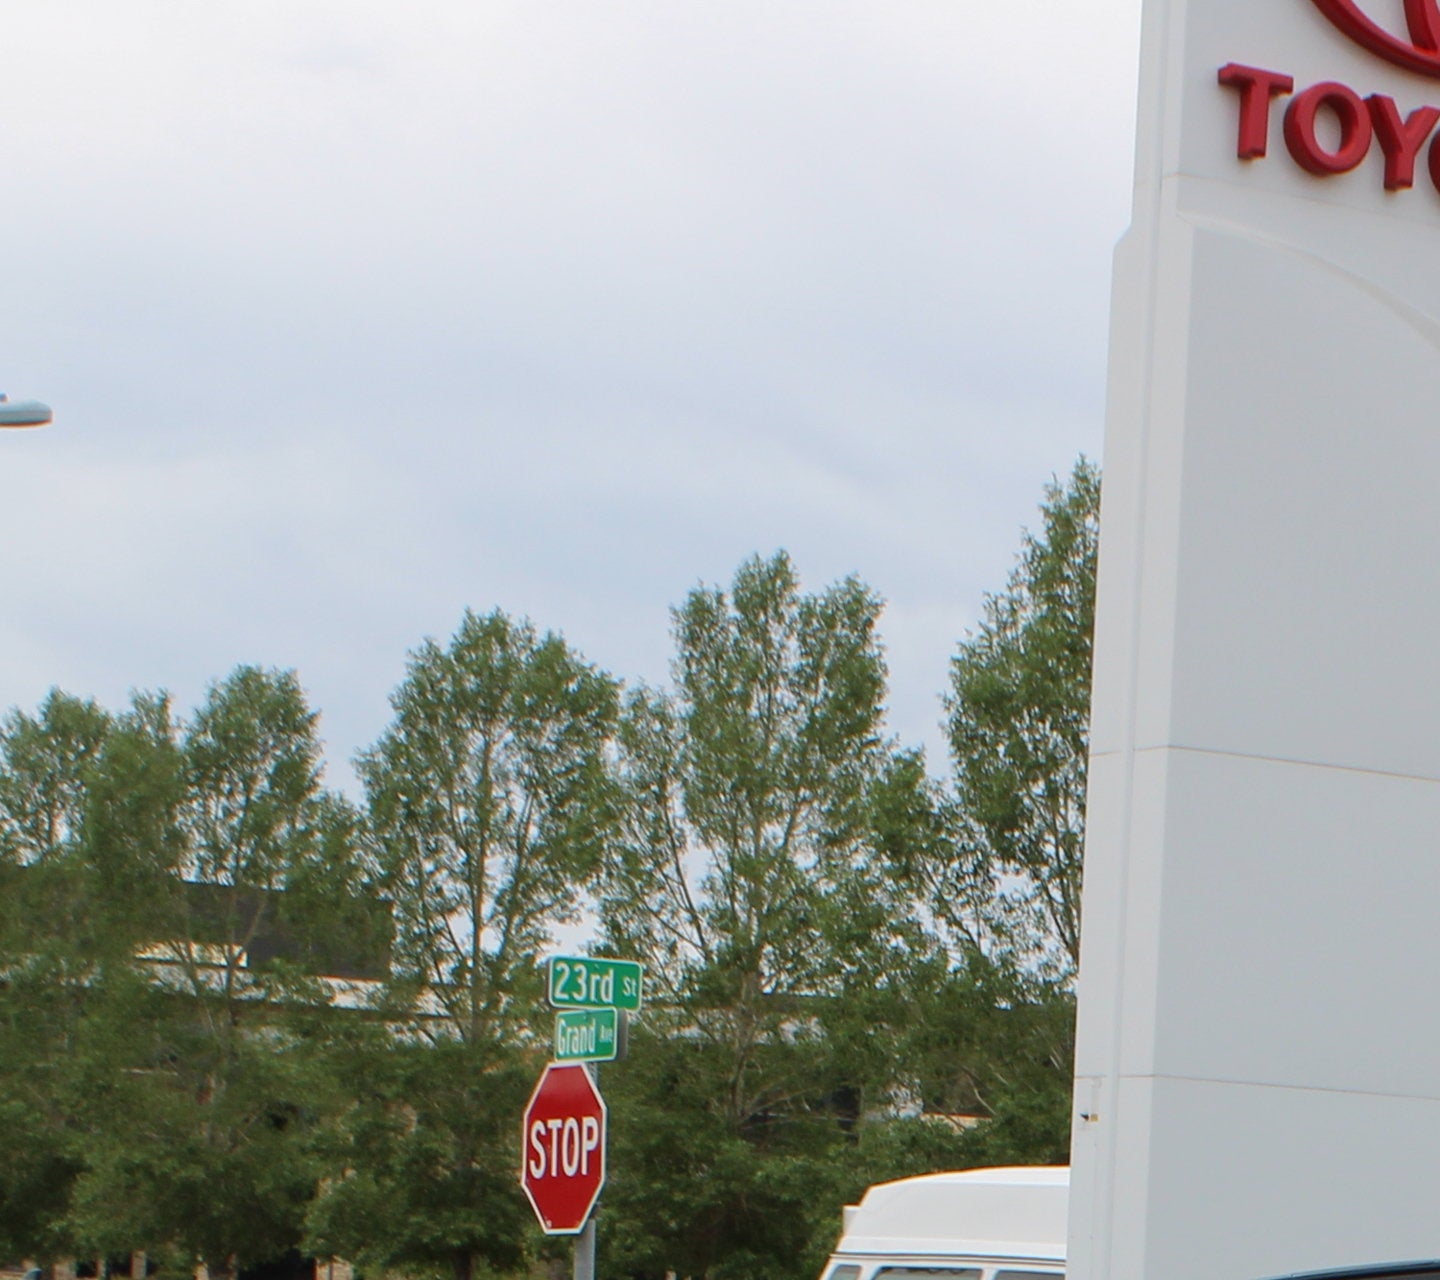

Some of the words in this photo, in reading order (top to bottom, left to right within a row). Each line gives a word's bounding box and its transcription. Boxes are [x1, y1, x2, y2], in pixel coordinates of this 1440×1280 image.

[554, 962, 614, 1004] 23rd
[623, 976, 637, 997] St
[558, 1017, 596, 1056] Grand
[529, 1116, 599, 1180] STOP
